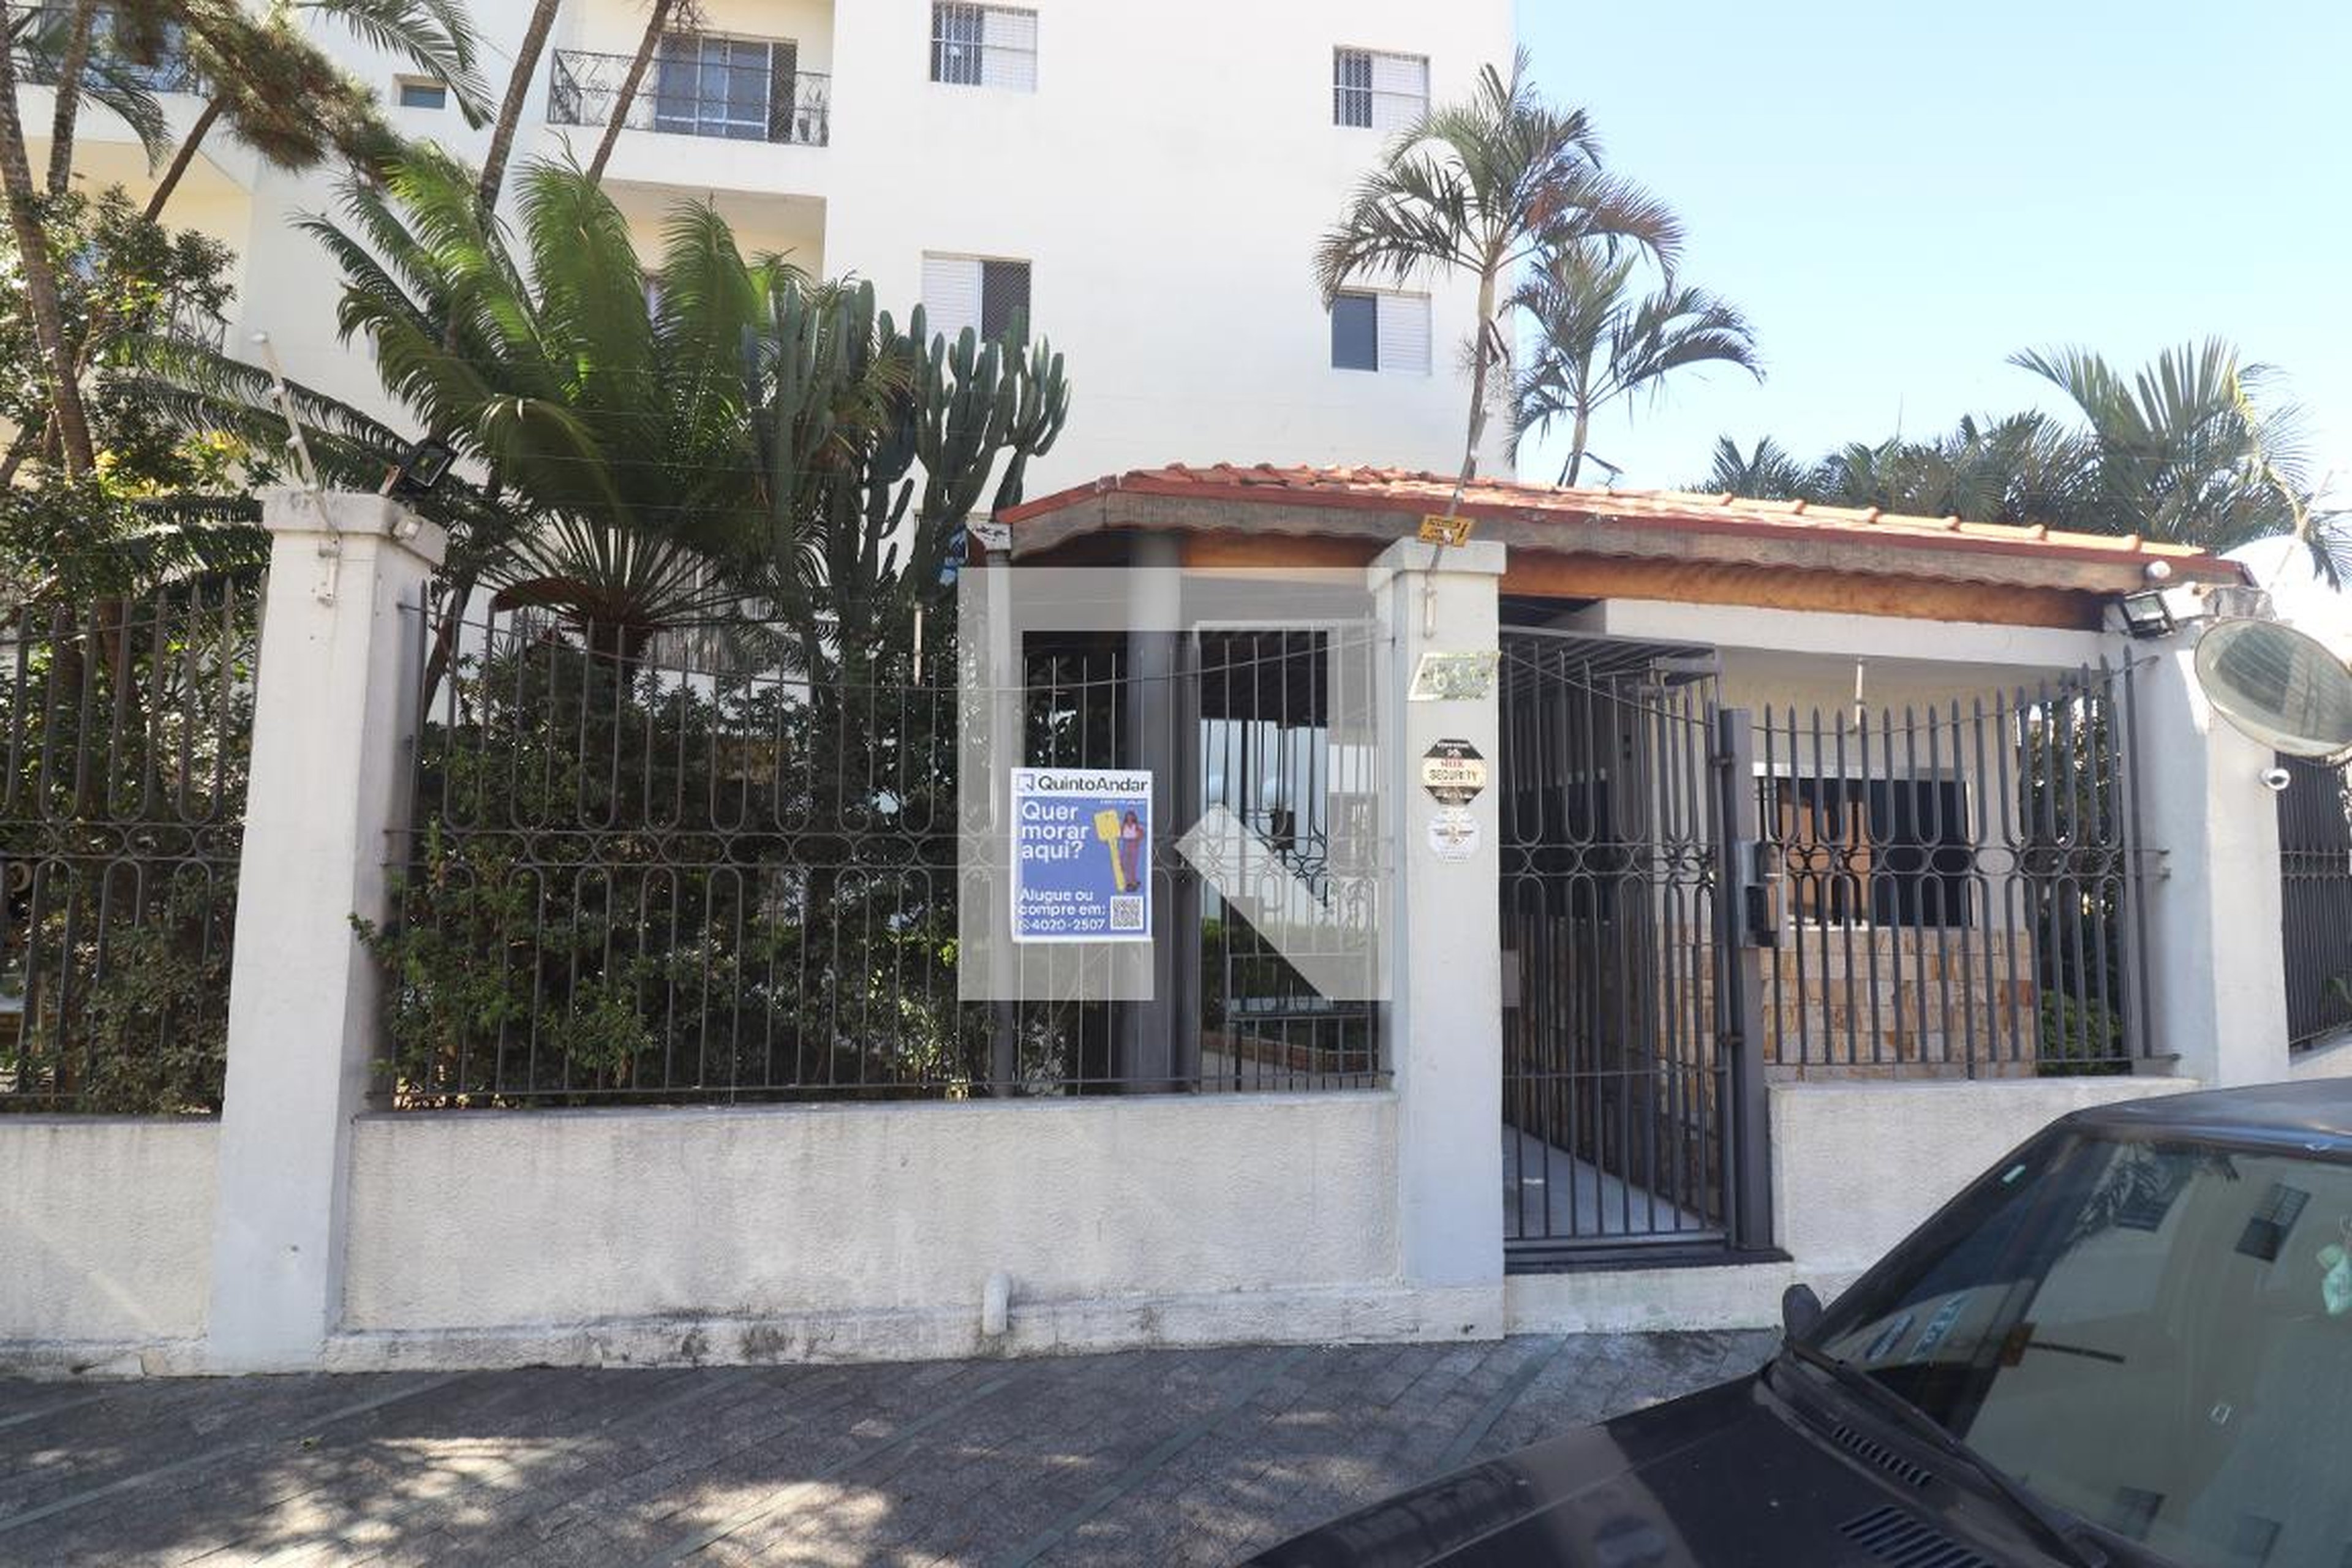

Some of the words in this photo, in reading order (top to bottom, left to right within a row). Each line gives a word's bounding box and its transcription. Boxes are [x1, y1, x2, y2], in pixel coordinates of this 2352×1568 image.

[1429, 769, 1477, 780] SECURITY
[1038, 775, 1148, 791] QuintoAndar
[1022, 801, 1079, 820] Quer
[1022, 825, 1089, 839] morar
[1022, 841, 1083, 863] aqui?
[1019, 889, 1071, 903] Alugue
[1076, 891, 1093, 901] ou
[1019, 904, 1076, 917] compre
[1079, 905, 1106, 915] em:
